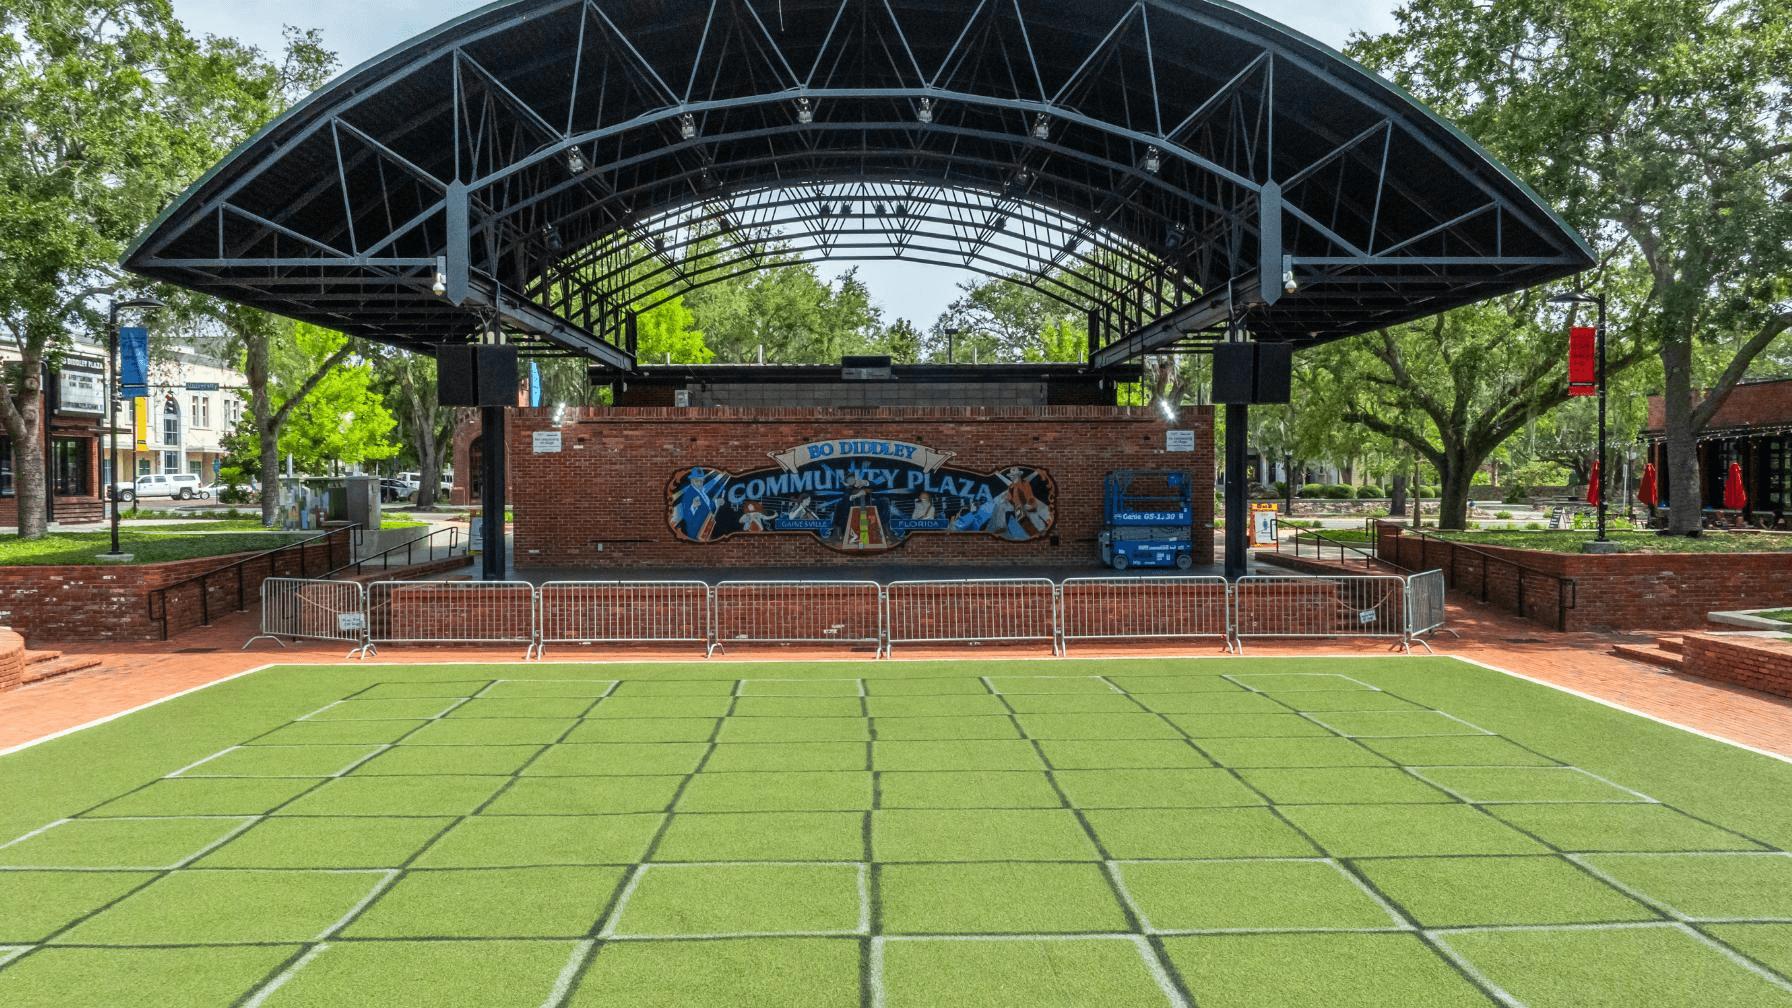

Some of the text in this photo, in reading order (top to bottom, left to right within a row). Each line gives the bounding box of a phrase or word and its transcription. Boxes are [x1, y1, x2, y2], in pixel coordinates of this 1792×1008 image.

[808, 441, 917, 459] BO DIDDLEY
[728, 469, 993, 504] COMMUNITY PLAZA
